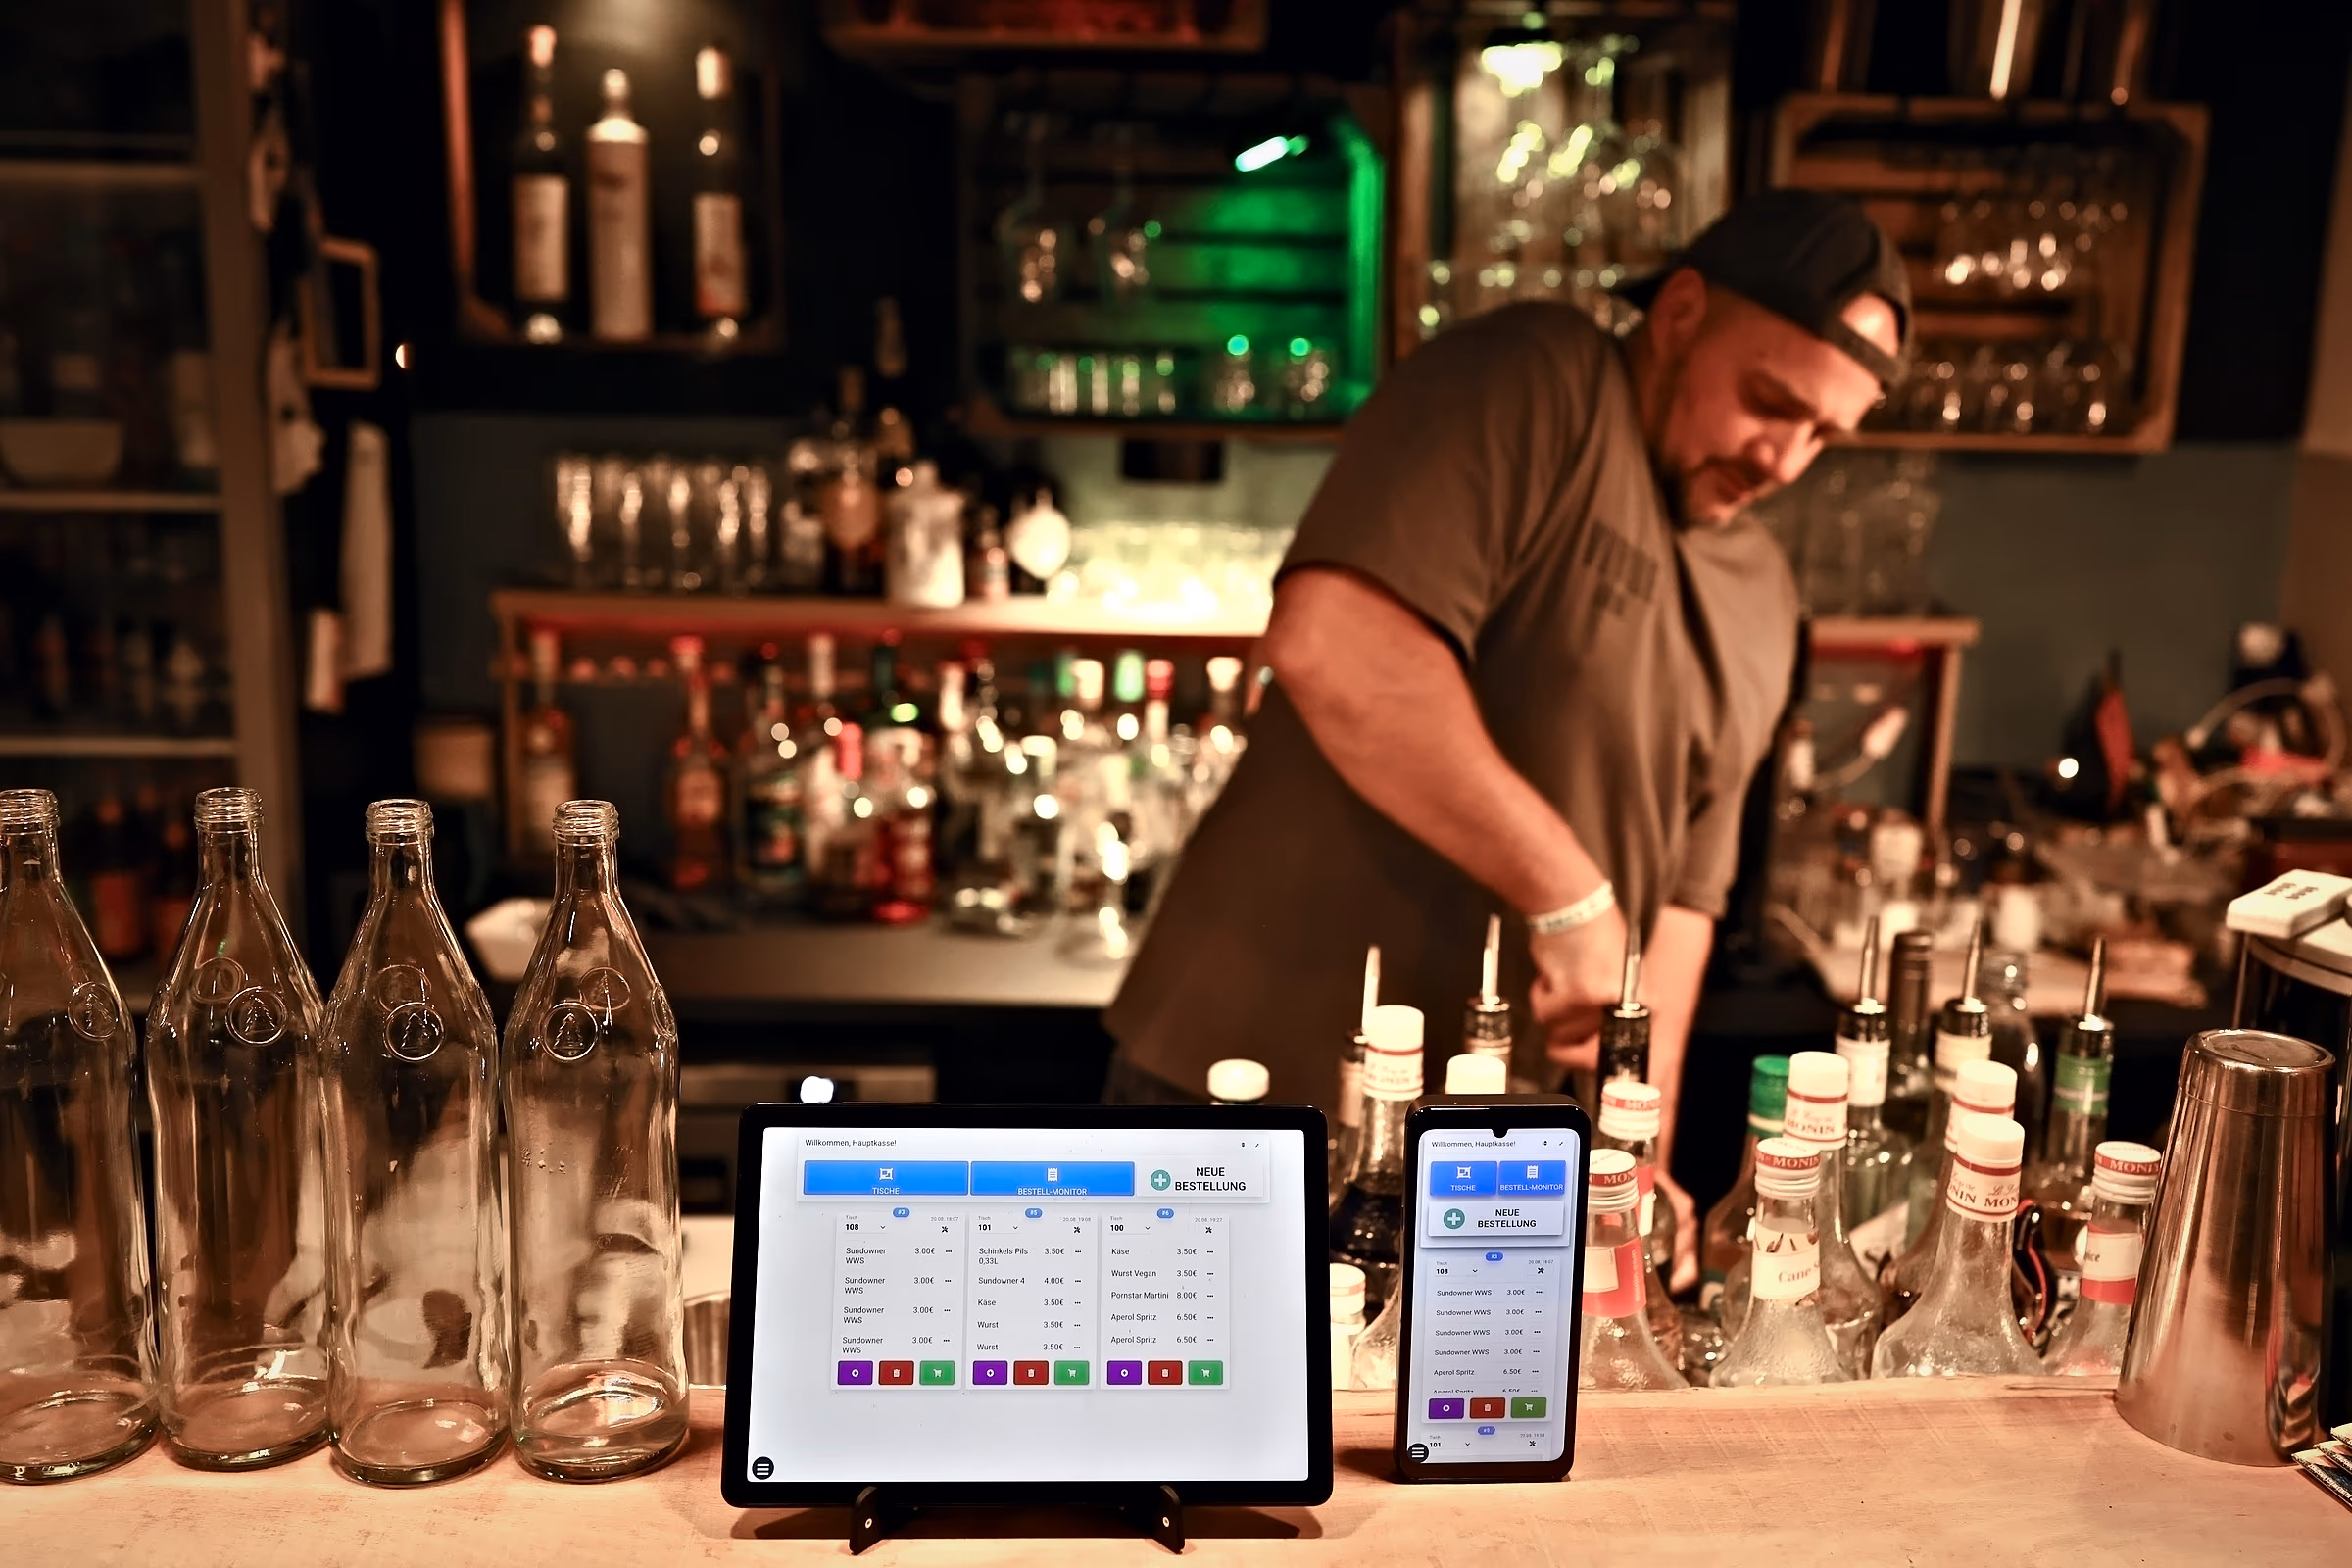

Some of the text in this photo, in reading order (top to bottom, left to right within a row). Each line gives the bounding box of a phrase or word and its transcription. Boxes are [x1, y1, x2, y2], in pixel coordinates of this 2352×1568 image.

[805, 1139, 851, 1148] Willkommen,
[1196, 1167, 1225, 1177] NEUE
[1174, 1181, 1247, 1192] BESTELLUNG
[1499, 1183, 1564, 1192] BESTELL-MONITOR
[1017, 1187, 1088, 1196] BESTELL-MONITOR
[1984, 1196, 2018, 1208] MON
[1495, 1208, 1520, 1217] NEUE
[1477, 1219, 1537, 1228] BESTELLUNG
[1110, 1313, 1135, 1322] Aperol
[1136, 1313, 1157, 1322] Spritz
[1110, 1336, 1135, 1345] Aperol
[1136, 1336, 1157, 1345] Spritz
